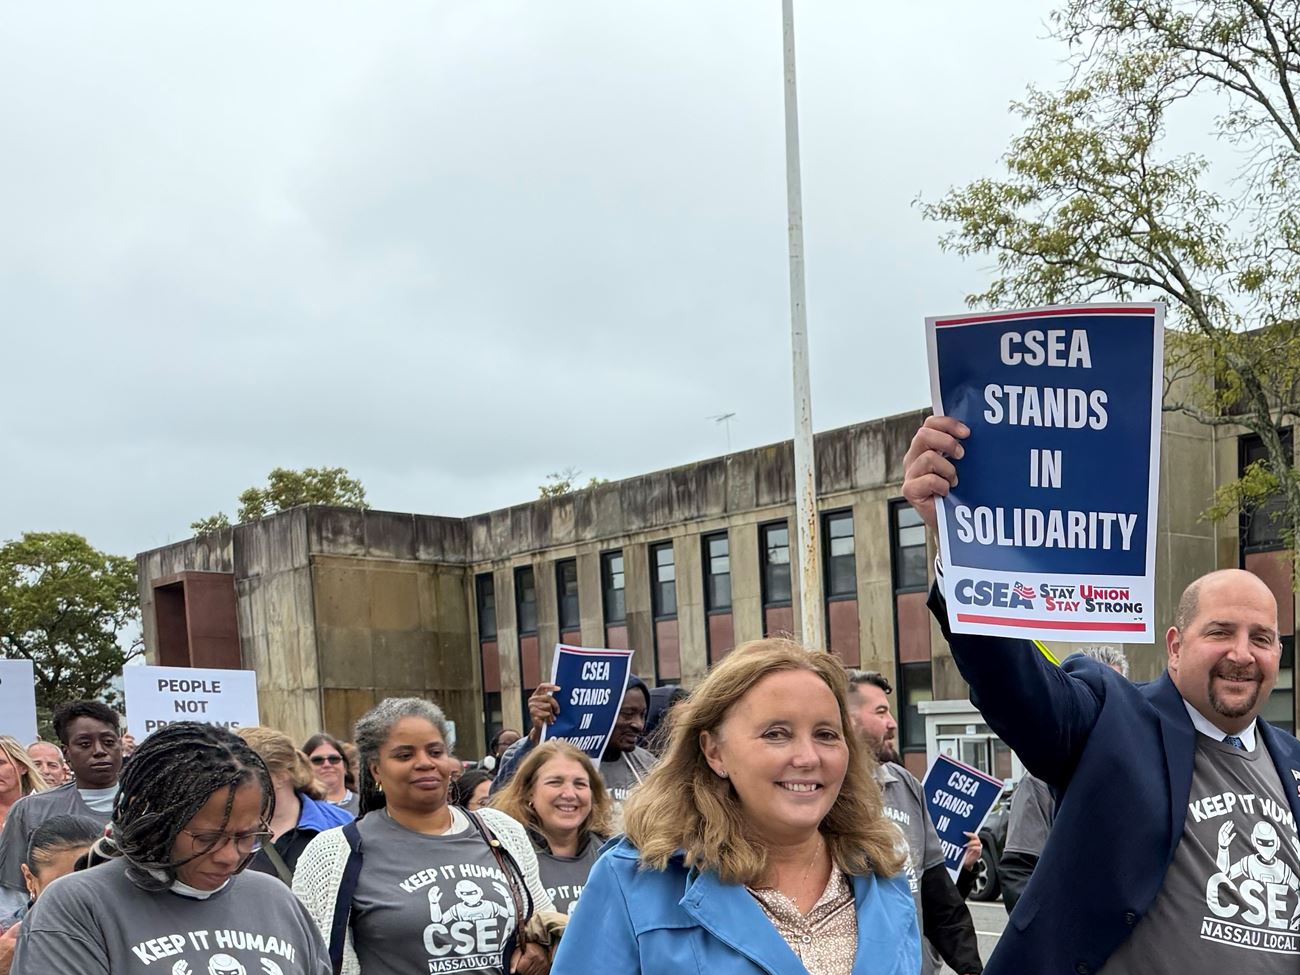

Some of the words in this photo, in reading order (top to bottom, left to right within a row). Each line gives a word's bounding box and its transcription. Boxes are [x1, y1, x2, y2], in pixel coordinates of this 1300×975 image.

[1000, 329, 1092, 369] CSEA
[984, 384, 1108, 430] STANDS
[1030, 449, 1062, 489] IN
[954, 504, 1138, 551] SOLIDARITY
[955, 579, 1034, 610] CSEA
[1040, 584, 1075, 599] STAY
[1080, 585, 1129, 600] UNION
[1046, 596, 1080, 612] STAY
[1085, 598, 1143, 613] STRONG
[581, 661, 610, 681] CSEA
[157, 679, 221, 693] PEOPLE
[570, 688, 611, 706] STANDS
[174, 700, 208, 713] NOT
[579, 713, 593, 730] IN
[947, 771, 980, 797] CSEA
[932, 789, 974, 818] STANDS
[1189, 791, 1237, 823] KEEP
[1238, 794, 1256, 815] IT
[936, 815, 951, 833] IN
[399, 868, 438, 893] KEEP
[440, 865, 456, 880] IT
[131, 934, 186, 966] KEEP
[188, 930, 210, 951] IT
[214, 930, 296, 964] HUMAN!
[1200, 920, 1261, 946] NASSAU
[1263, 933, 1297, 951] LOCAL
[428, 957, 475, 973] NASSAU
